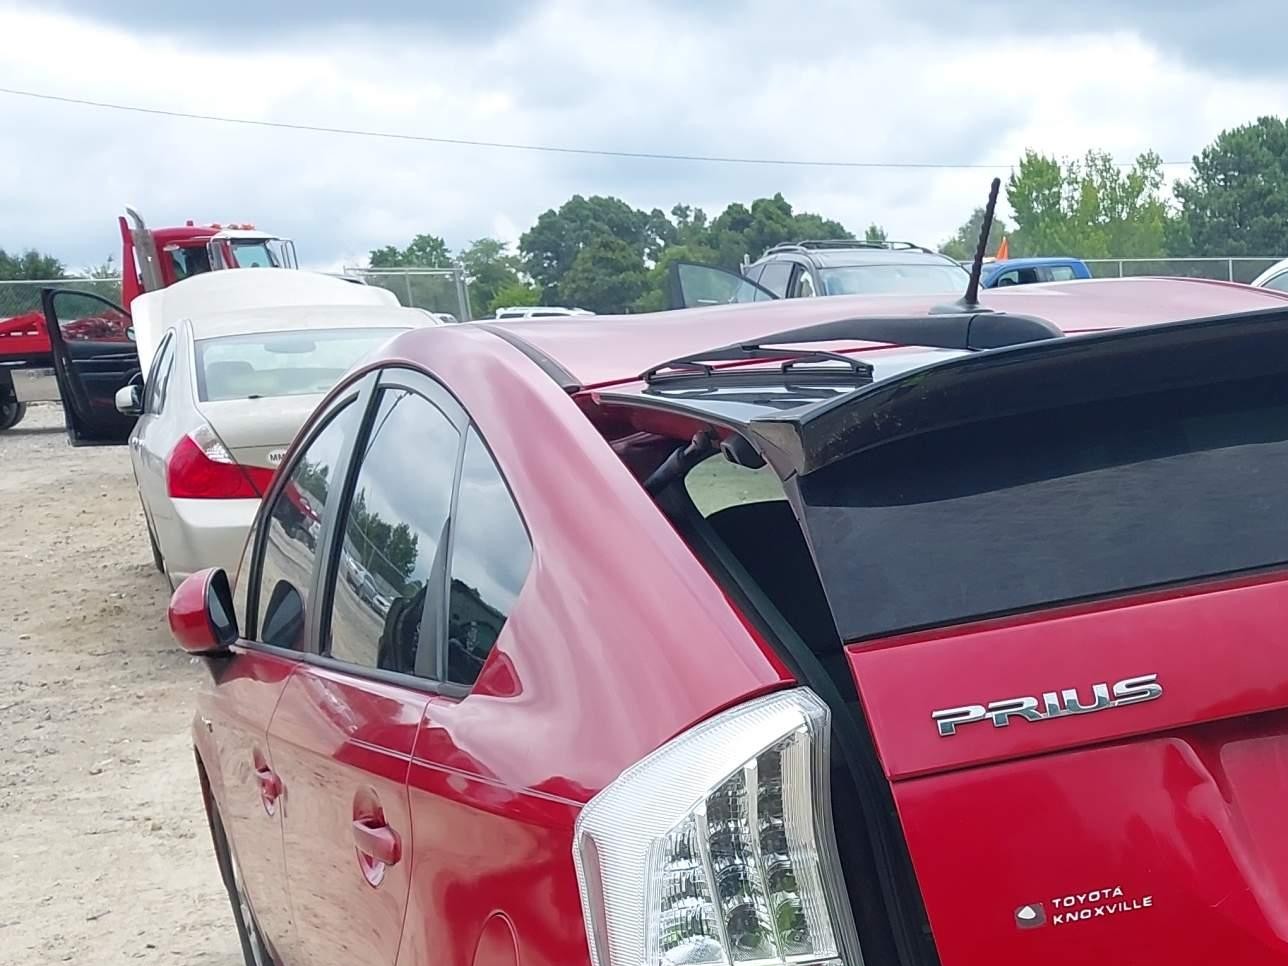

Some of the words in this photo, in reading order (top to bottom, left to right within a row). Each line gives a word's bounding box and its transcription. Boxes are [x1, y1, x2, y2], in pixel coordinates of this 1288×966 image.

[932, 673, 1163, 737] PRIUS
[1051, 886, 1124, 908] TOYOTA
[1052, 896, 1153, 926] KNOXVILLE
